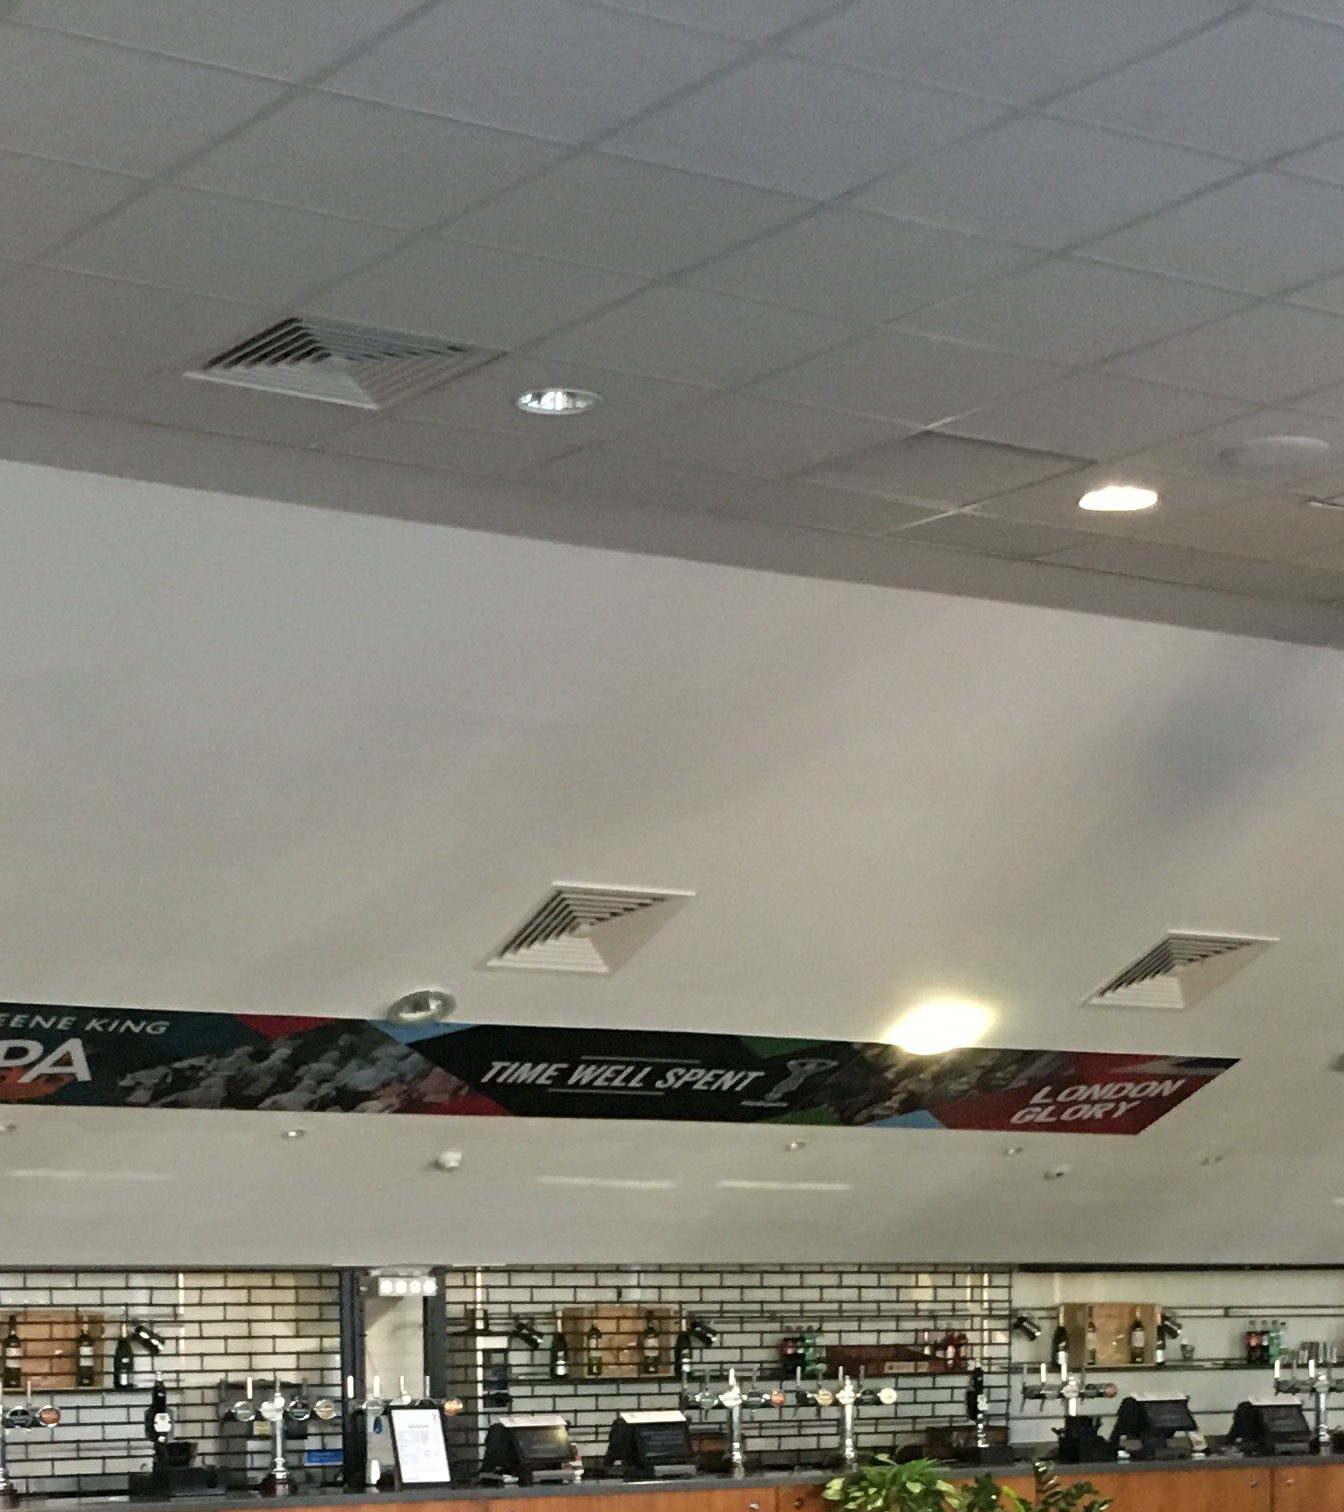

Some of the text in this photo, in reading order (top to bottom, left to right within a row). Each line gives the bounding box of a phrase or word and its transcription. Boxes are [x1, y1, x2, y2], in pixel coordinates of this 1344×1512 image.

[85, 1018, 170, 1034] KING
[481, 1061, 766, 1091] TIME WELL SPENT
[1028, 1078, 1186, 1104] LONDON
[1009, 1100, 1142, 1124] GLORY
